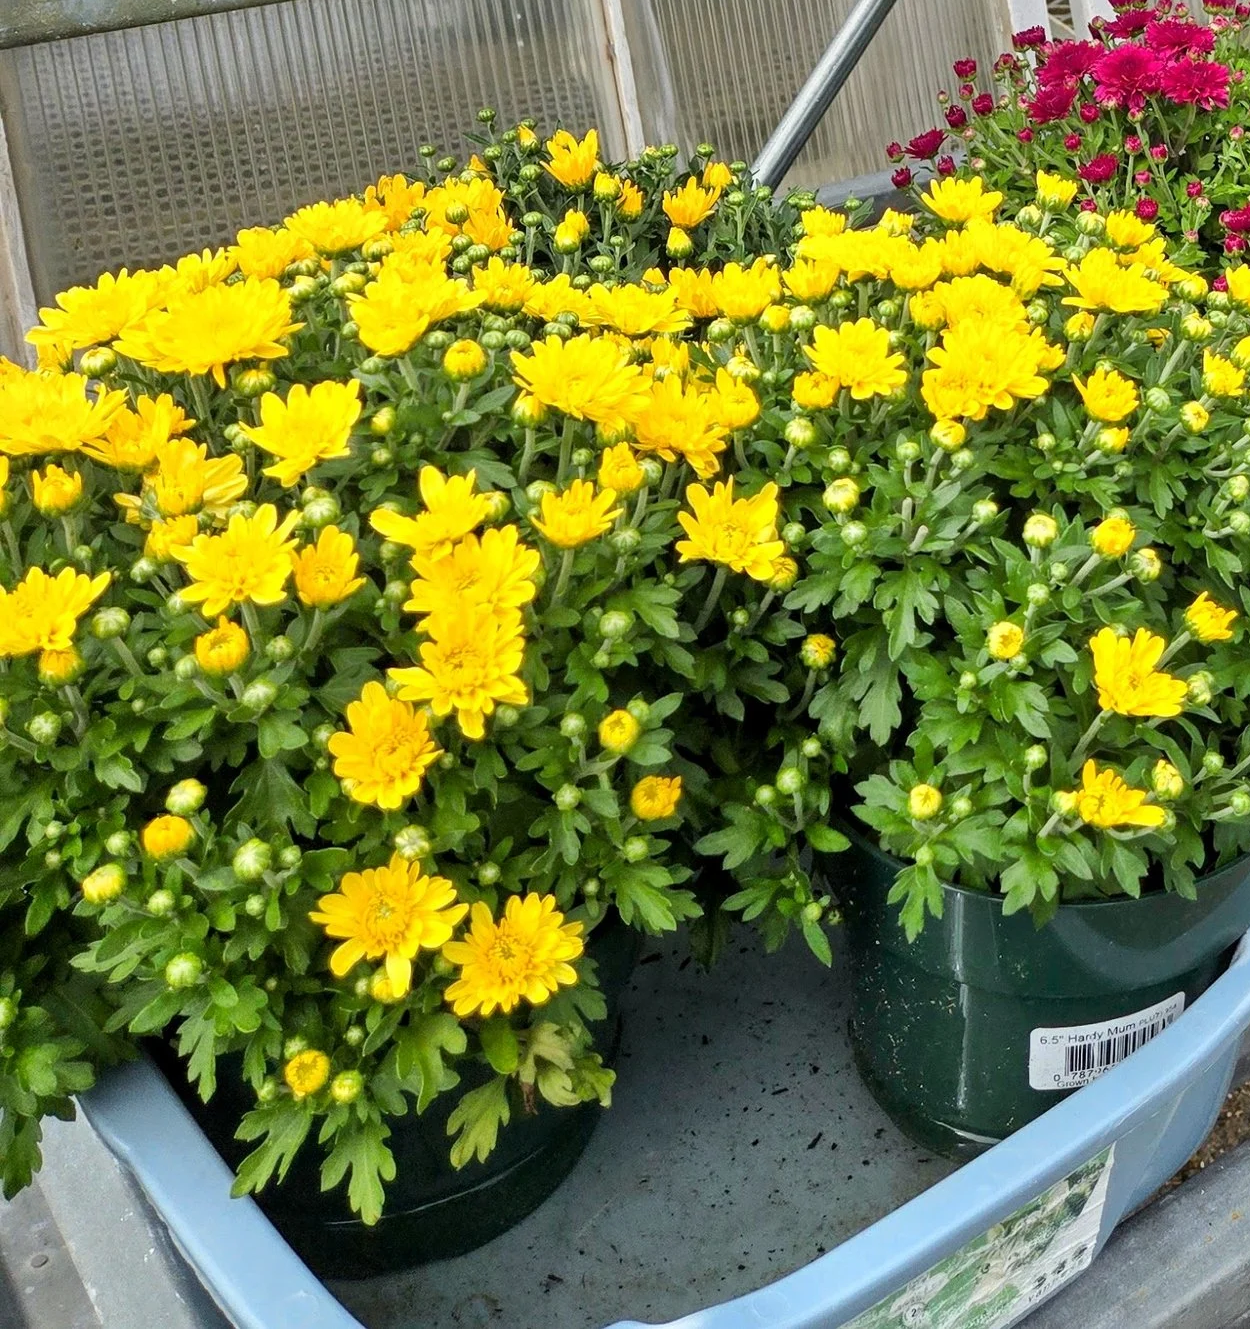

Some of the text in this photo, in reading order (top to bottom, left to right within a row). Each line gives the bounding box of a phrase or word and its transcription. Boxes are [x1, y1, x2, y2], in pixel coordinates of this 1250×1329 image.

[1040, 1035, 1065, 1045] 6.5"
[1068, 1030, 1104, 1044] Hardy
[1107, 1022, 1136, 1037] Mum
[1053, 1074, 1061, 1083] 0
[1056, 1079, 1089, 1089] Grown
